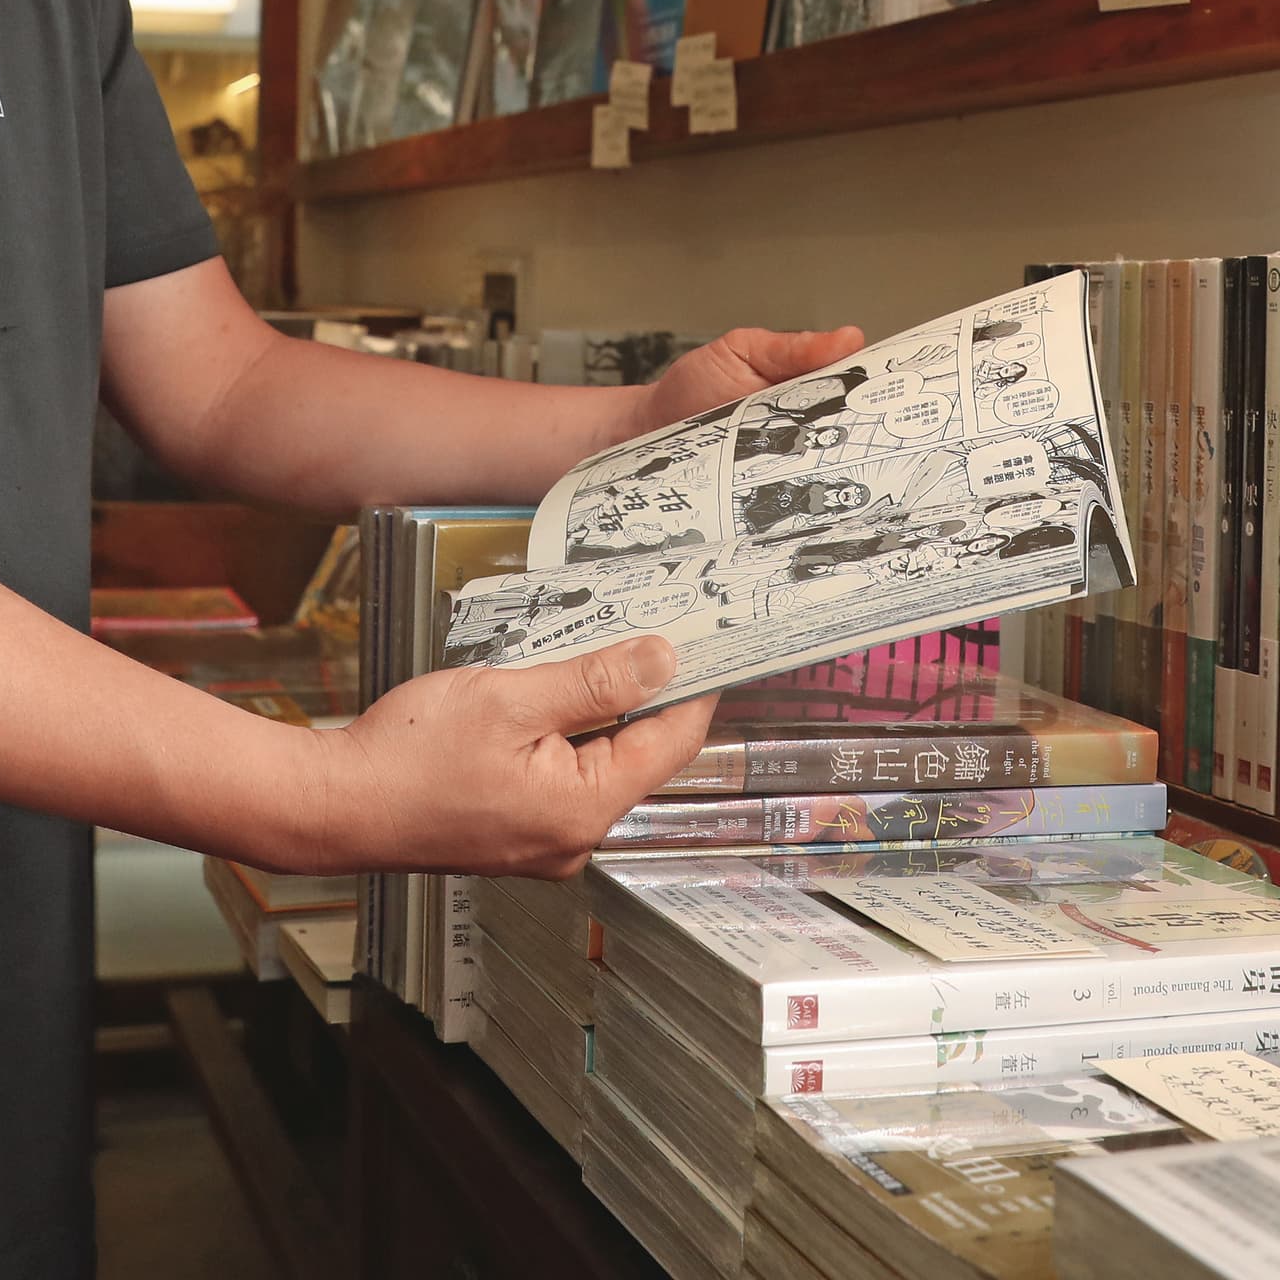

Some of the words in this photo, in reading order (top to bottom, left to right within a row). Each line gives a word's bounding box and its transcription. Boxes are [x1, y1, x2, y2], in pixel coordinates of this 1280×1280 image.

[1003, 748, 1014, 778] Light
[785, 801, 797, 841] CHASER
[798, 807, 811, 836] WIND
[1132, 981, 1170, 998] Sprout
[1171, 977, 1214, 995] Banana
[1215, 977, 1235, 994] The
[1071, 987, 1092, 1004] 3
